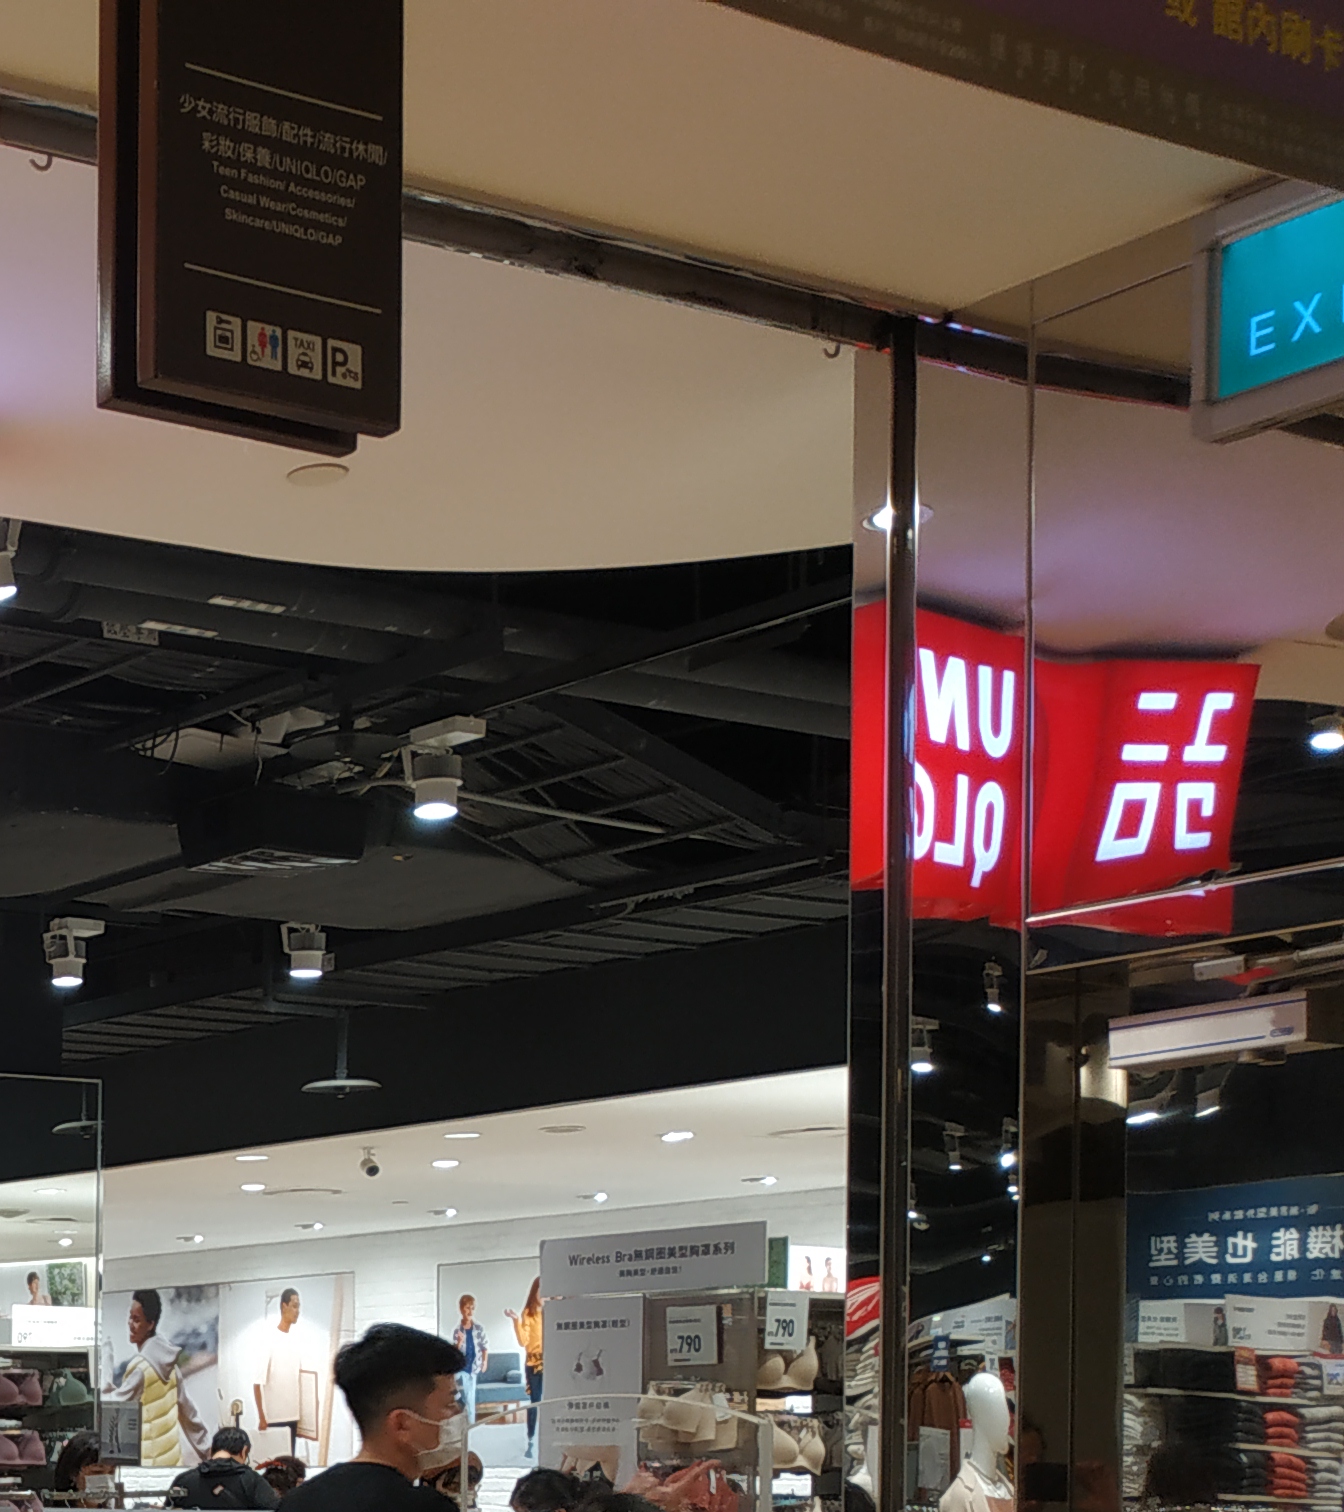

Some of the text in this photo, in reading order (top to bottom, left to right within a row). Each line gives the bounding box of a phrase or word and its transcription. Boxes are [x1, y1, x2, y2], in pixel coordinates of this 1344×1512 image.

[212, 161, 238, 178] Teen
[220, 185, 257, 205] Casual
[292, 336, 316, 353] TAXI
[568, 1251, 611, 1268] Wireless
[773, 1318, 796, 1338] 790
[676, 1334, 702, 1354] 790
